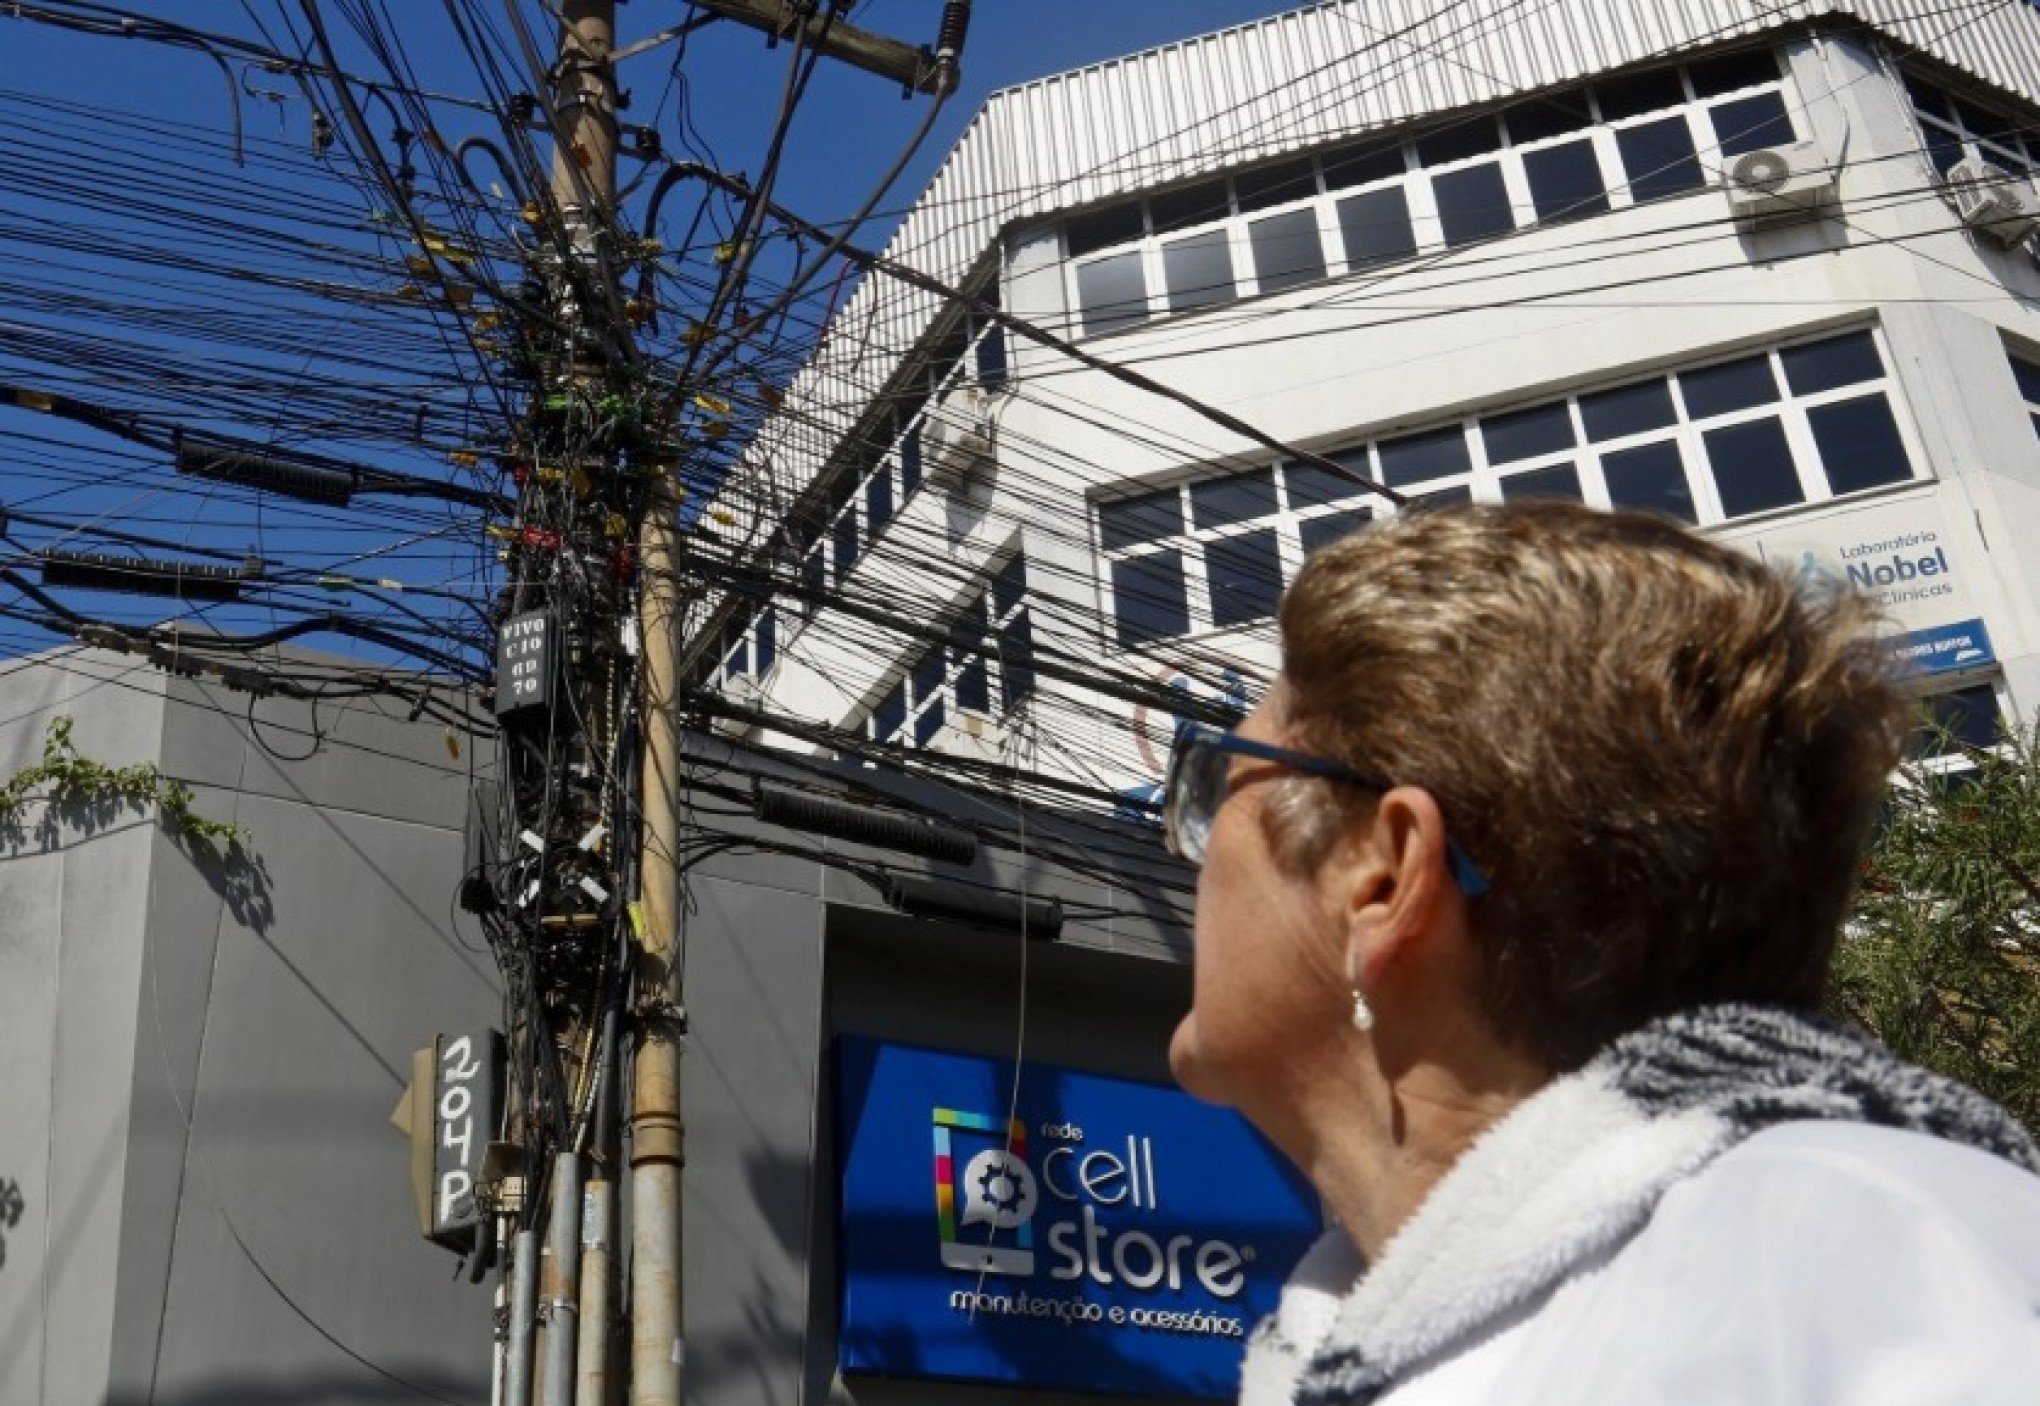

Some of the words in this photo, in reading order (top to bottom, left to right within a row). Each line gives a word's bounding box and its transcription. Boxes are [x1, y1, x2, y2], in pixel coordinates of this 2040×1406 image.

[1840, 531, 1936, 558] Laboratório
[1846, 546, 1948, 587] Nobel
[1041, 1122, 1083, 1140] rede
[1042, 1135, 1156, 1209] cell
[951, 1290, 1102, 1325] manutenção
[1108, 1306, 1125, 1324] e
